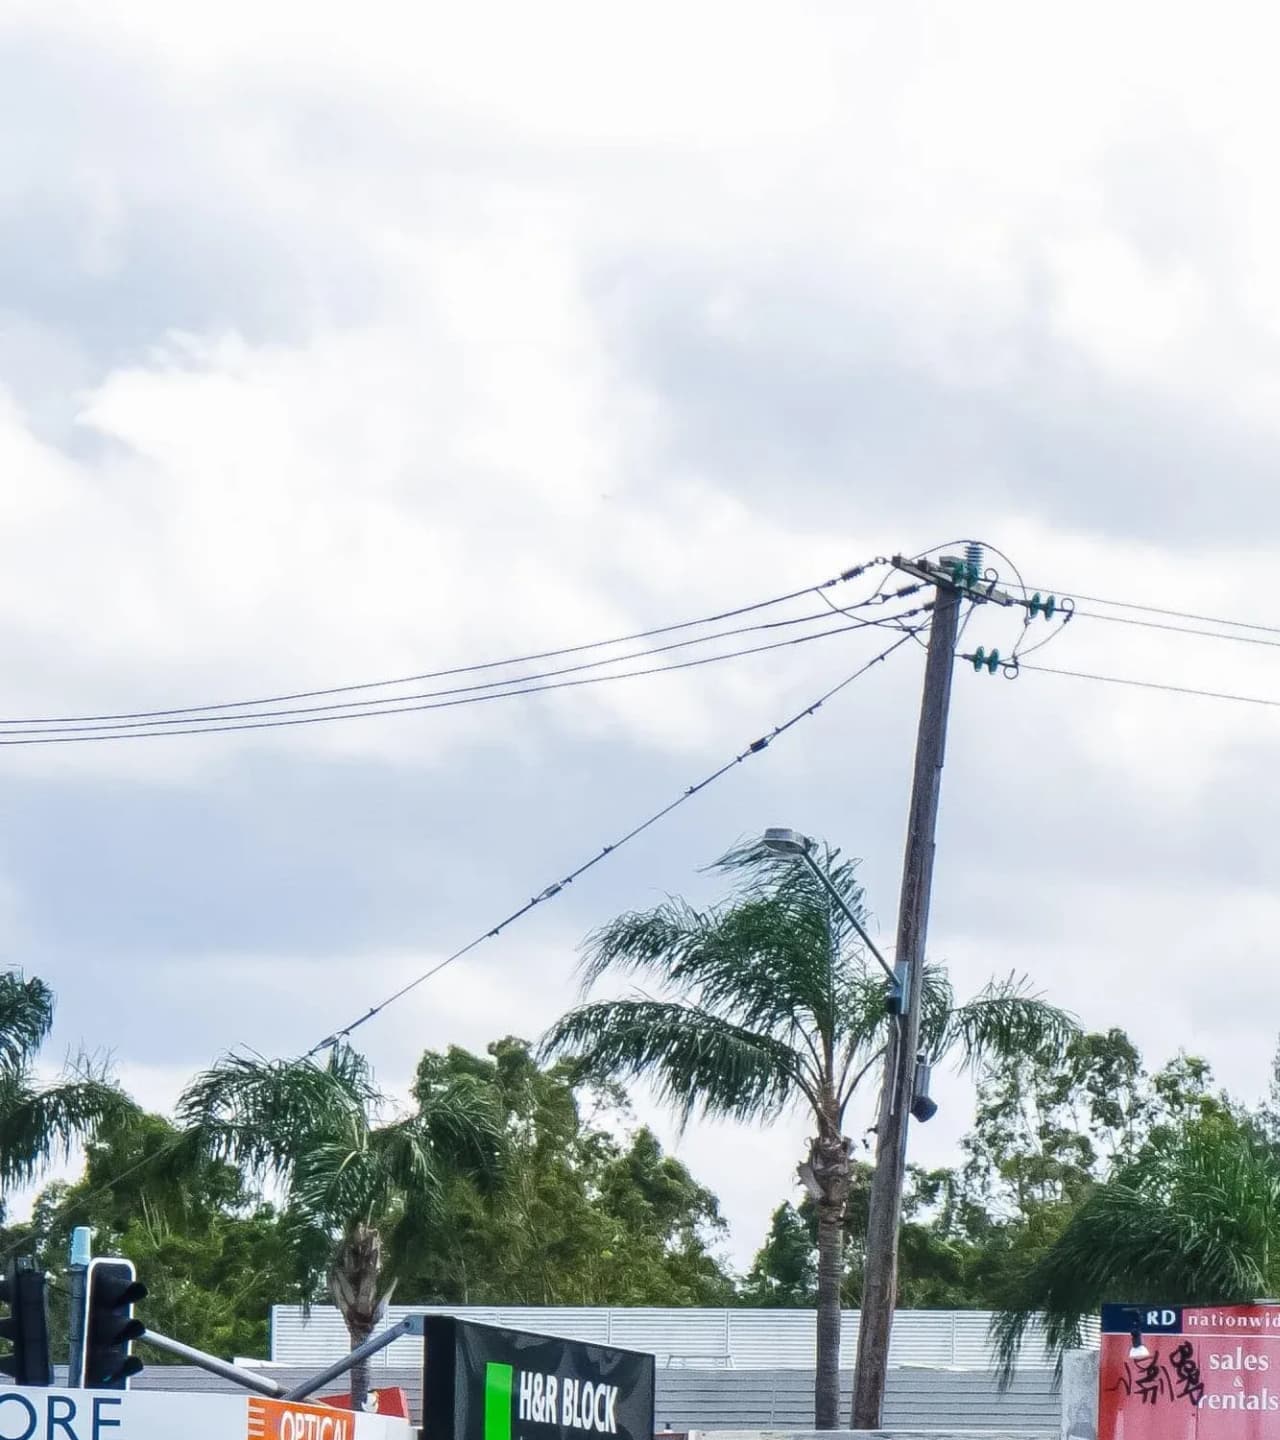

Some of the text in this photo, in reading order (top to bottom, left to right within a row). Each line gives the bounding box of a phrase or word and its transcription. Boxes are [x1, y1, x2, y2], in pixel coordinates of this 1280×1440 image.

[1146, 1310, 1176, 1326] RD
[1208, 1346, 1270, 1371] sales
[1231, 1375, 1244, 1388] &
[519, 1371, 619, 1434] H&R BLOCK
[1197, 1388, 1279, 1411] rentals
